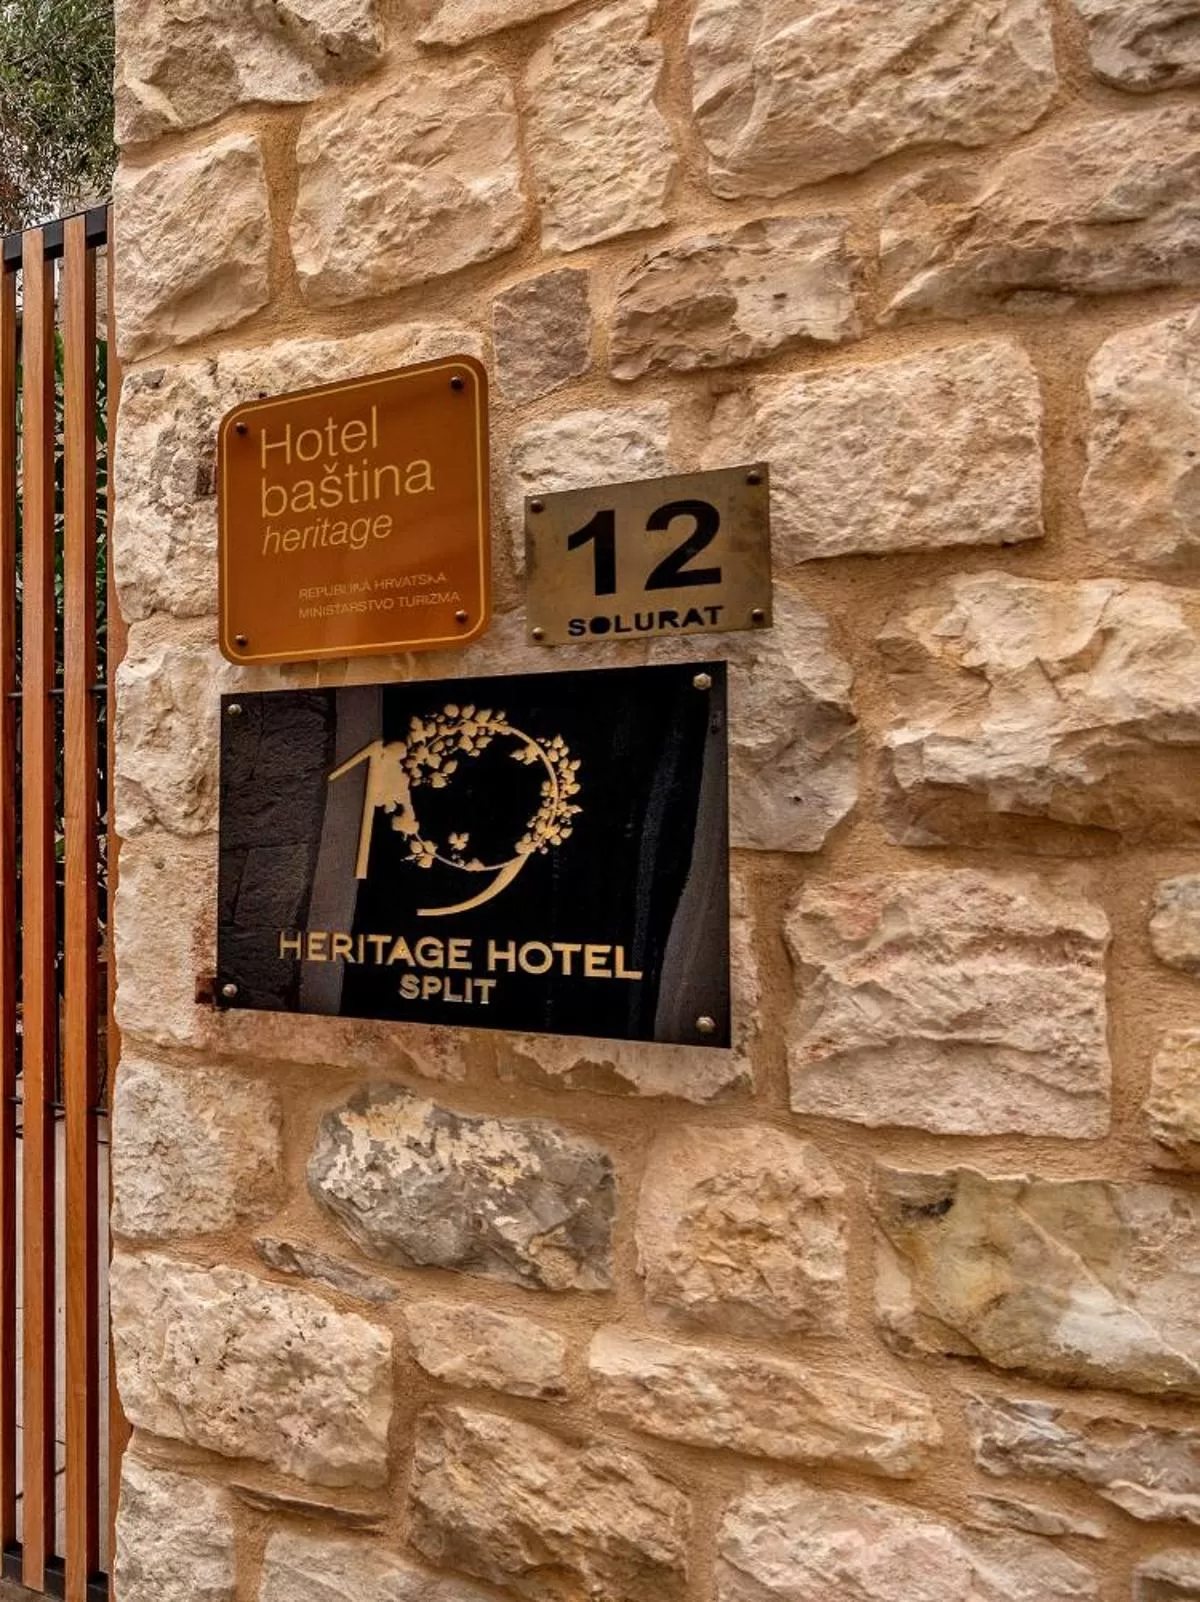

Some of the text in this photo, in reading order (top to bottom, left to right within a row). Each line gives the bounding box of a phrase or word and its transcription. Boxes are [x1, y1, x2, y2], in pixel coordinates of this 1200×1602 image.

[260, 405, 379, 469] Hotel
[261, 457, 434, 519] baština
[262, 513, 393, 556] heritage
[567, 499, 722, 596] 12
[299, 591, 460, 618] MINISTARSTVO TURIZMA
[568, 605, 724, 637] SOLURAT
[279, 931, 643, 981] HERITAGE HOTEL
[399, 974, 497, 1005] SPLIT
